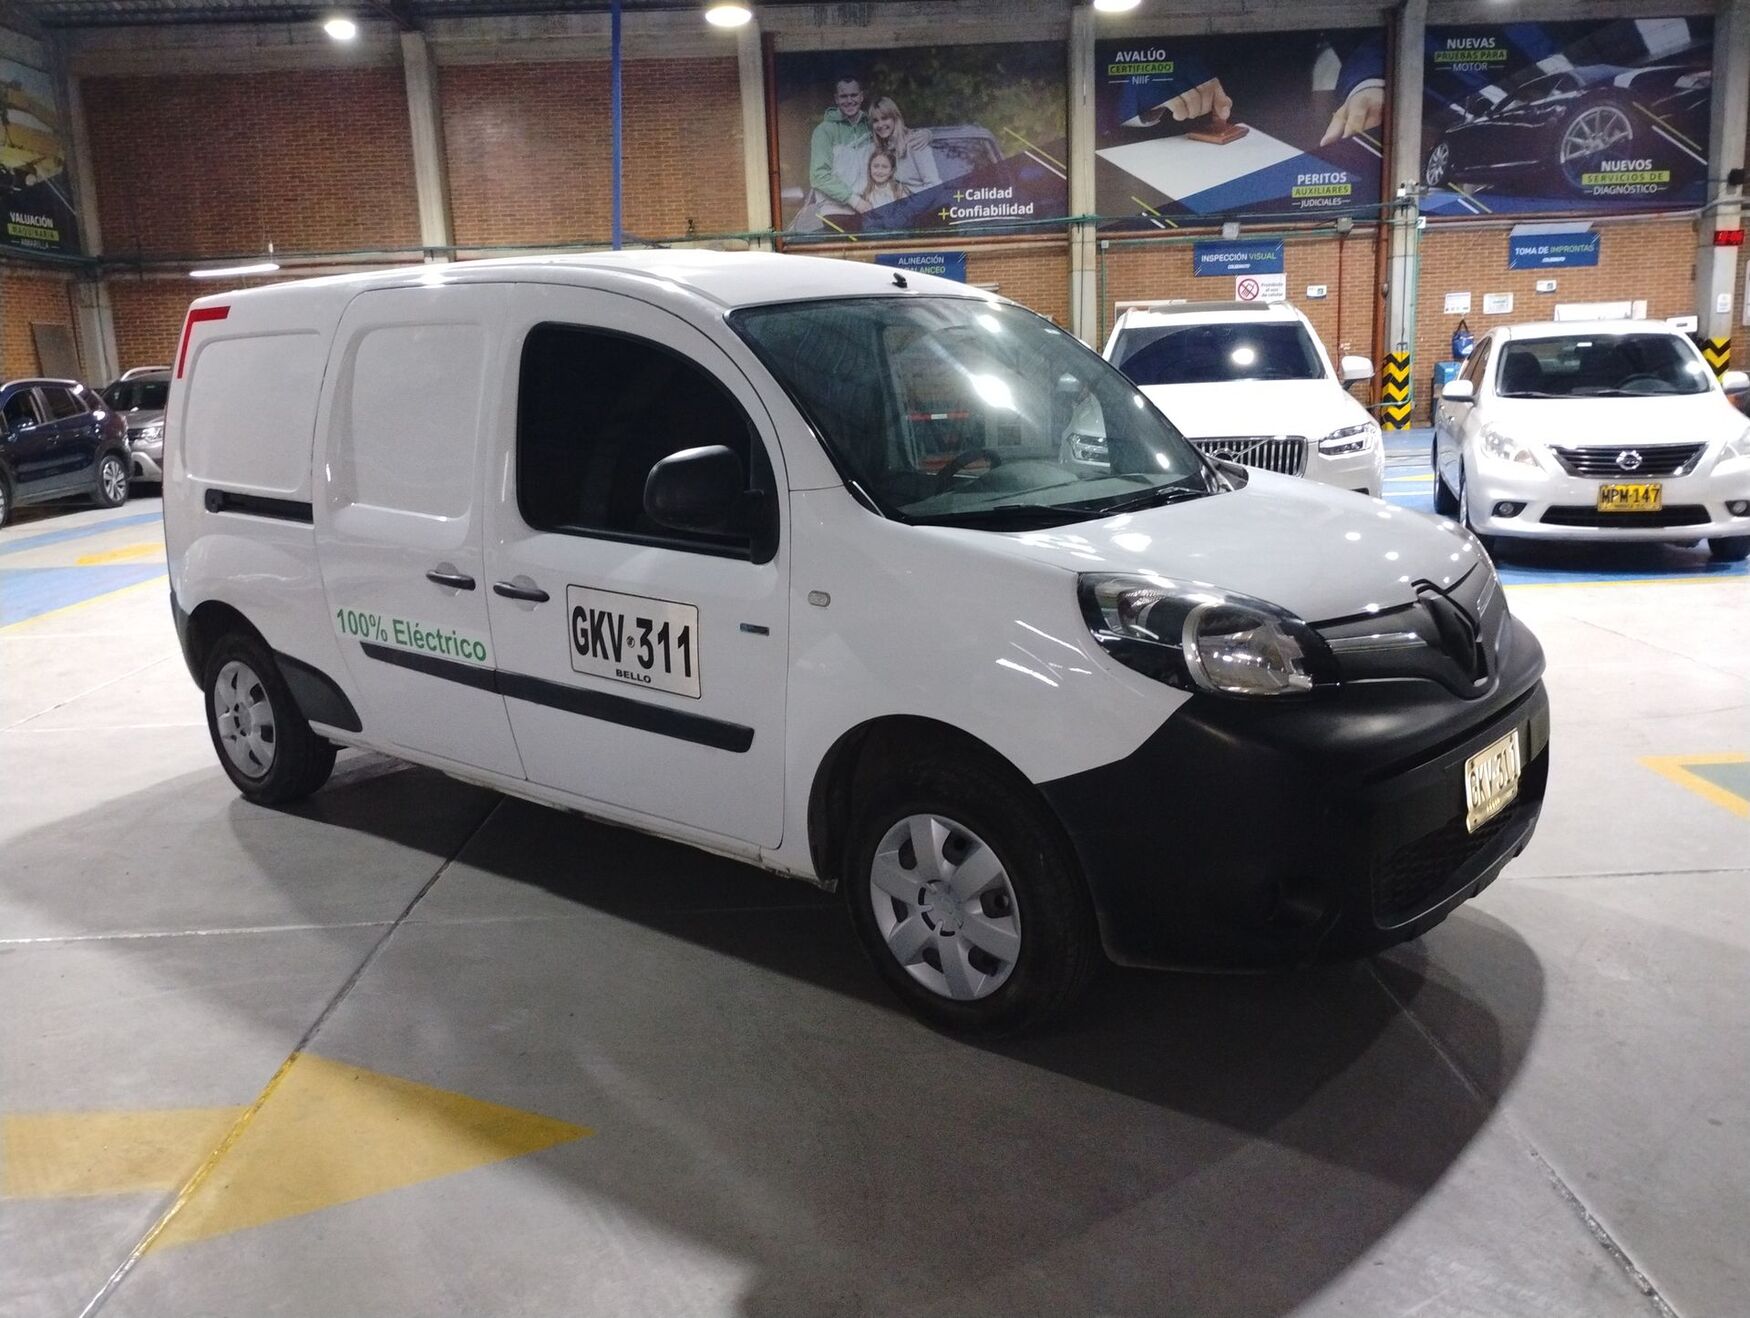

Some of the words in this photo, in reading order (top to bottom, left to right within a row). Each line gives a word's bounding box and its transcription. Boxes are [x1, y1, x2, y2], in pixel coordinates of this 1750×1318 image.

[1446, 37, 1496, 49] NUEVAS
[1115, 47, 1167, 62] AVALÚO
[1436, 51, 1479, 61] PRUEBAS
[1480, 50, 1505, 60] PARA
[1110, 63, 1172, 74] CERTIFICADO
[1452, 62, 1489, 72] MOTOR
[1600, 159, 1653, 171] NUEVOS
[1297, 171, 1347, 185] PERITOS
[1587, 173, 1645, 184] SERVICIOS
[1649, 172, 1664, 182] DE
[1294, 185, 1350, 196] AUXILIARES
[1592, 184, 1658, 196] DIAGNÓSTICO
[1300, 198, 1342, 209] JUDICIALES
[9, 211, 54, 229] VALUACIÓN
[1515, 247, 1537, 256] TOMA
[1538, 246, 1549, 255] DE
[1550, 244, 1595, 253] IMPRONTAS
[898, 254, 945, 267] ALINEACIÓN
[1201, 252, 1248, 263] INSPECCIÓN
[1248, 252, 1277, 261] VISUAL
[336, 608, 388, 642] 100%
[392, 618, 487, 662] Eléctrico
[615, 668, 652, 684] BELLO
